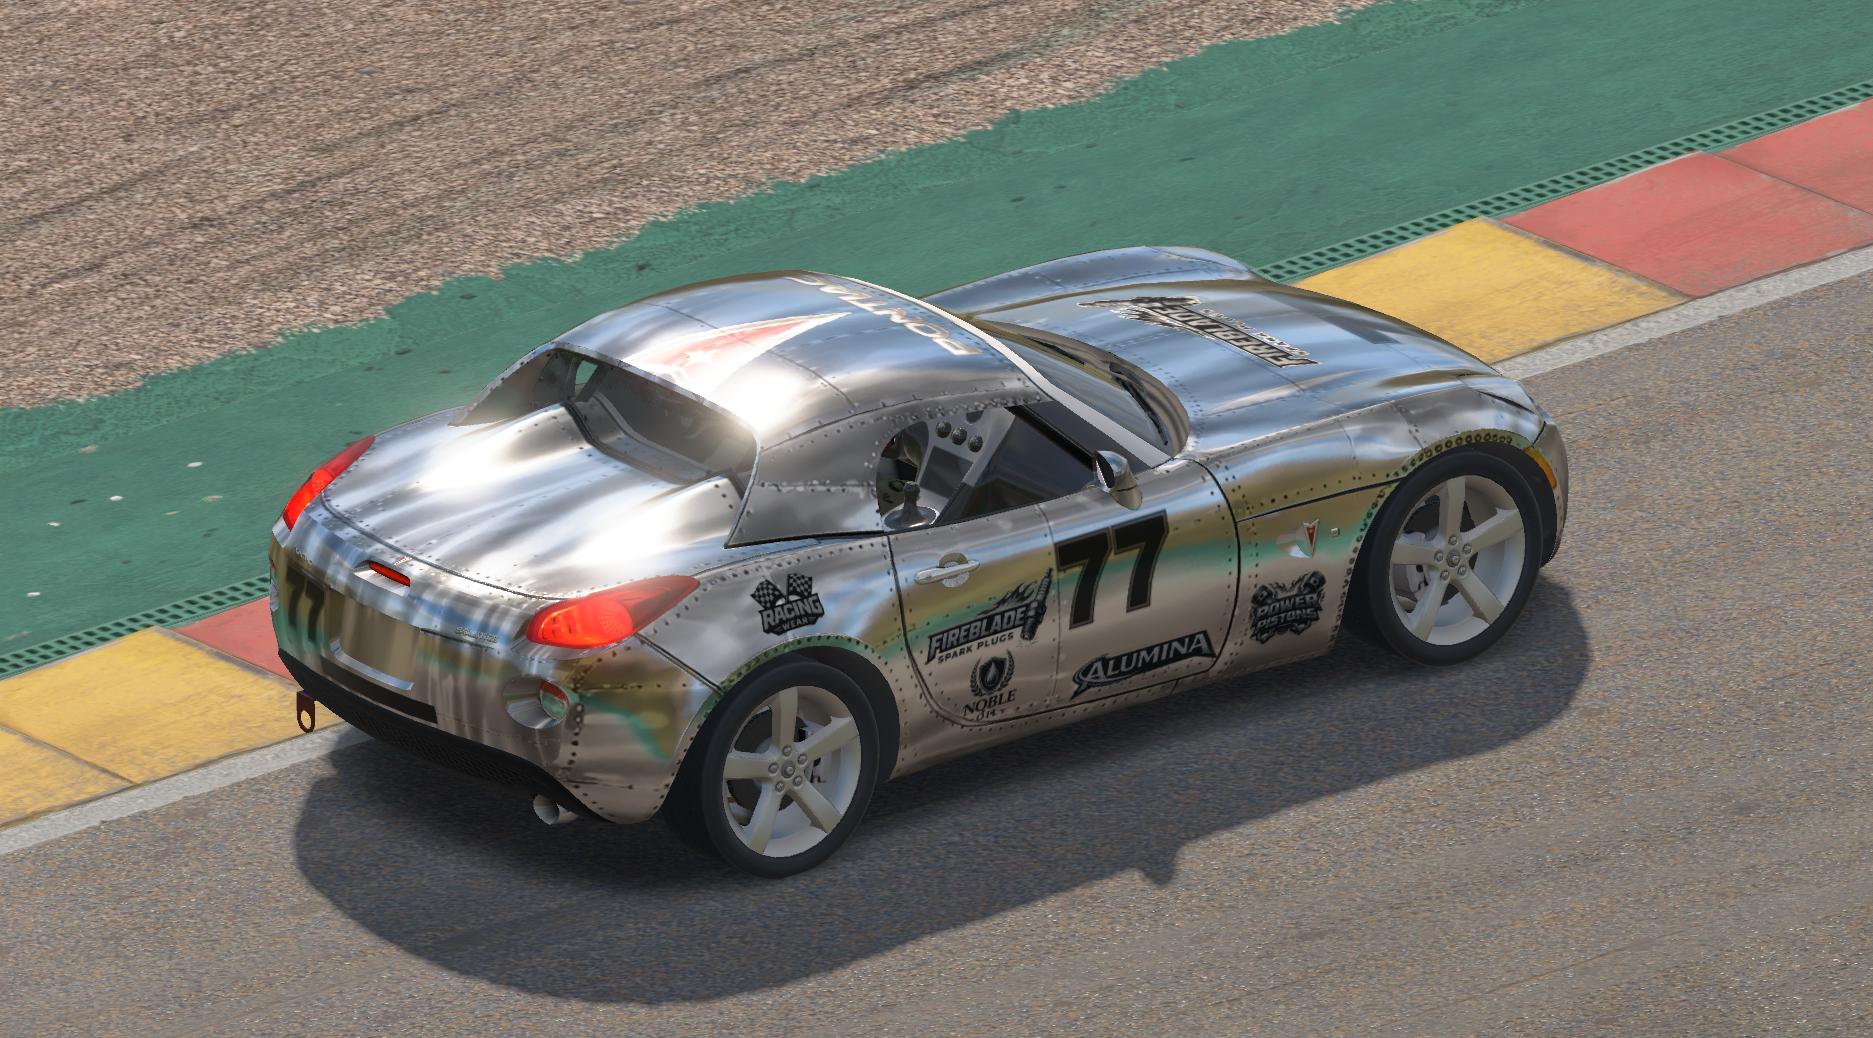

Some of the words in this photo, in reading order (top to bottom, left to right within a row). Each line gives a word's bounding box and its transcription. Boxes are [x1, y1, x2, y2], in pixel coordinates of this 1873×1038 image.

[1149, 302, 1318, 368] FIREBLADE
[1055, 510, 1169, 629] 77
[763, 596, 822, 629] RACING
[1257, 594, 1318, 618] POWER
[1257, 608, 1317, 628] PISTONS
[783, 616, 809, 631] WEAR
[926, 607, 1027, 664] FIREBLADE
[938, 645, 973, 664] SPARK
[977, 631, 1014, 650] PLUGS
[1077, 632, 1211, 693] ALUMINA
[964, 689, 1017, 717] NOBLE
